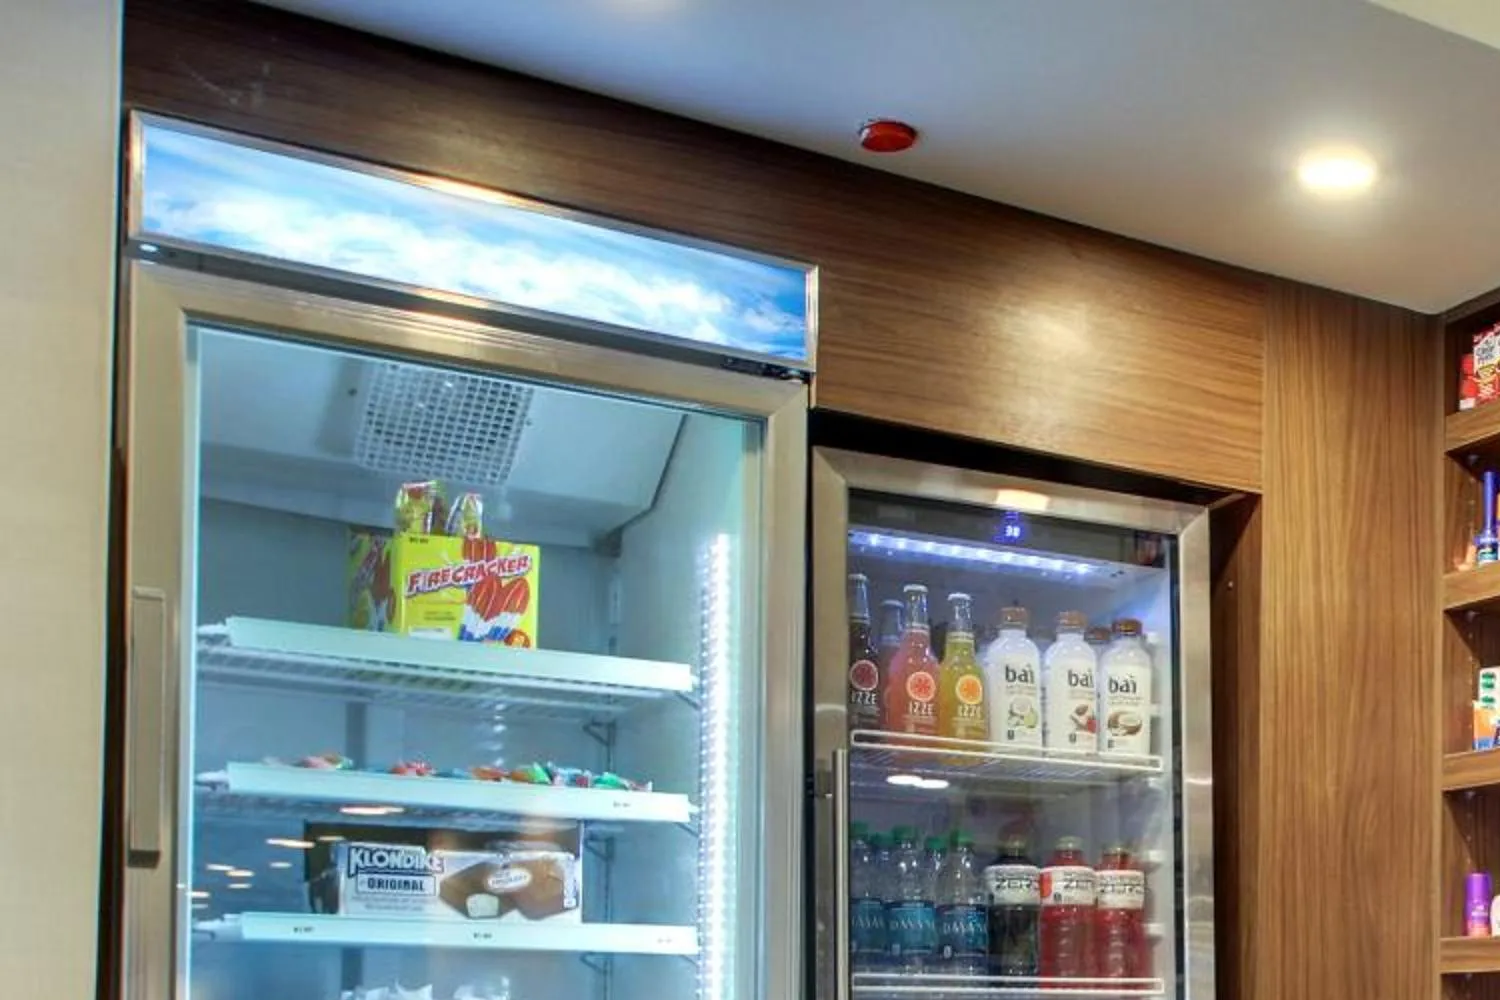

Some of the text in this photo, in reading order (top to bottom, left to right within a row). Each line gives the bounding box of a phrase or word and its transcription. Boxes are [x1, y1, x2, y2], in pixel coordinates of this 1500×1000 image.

[405, 554, 532, 599] FIRECRACKER
[1004, 663, 1035, 683] bai
[1108, 673, 1137, 694] bai
[907, 701, 934, 715] IZZE
[347, 845, 444, 876] KLONDIKE
[366, 876, 426, 893] ORIGINAL
